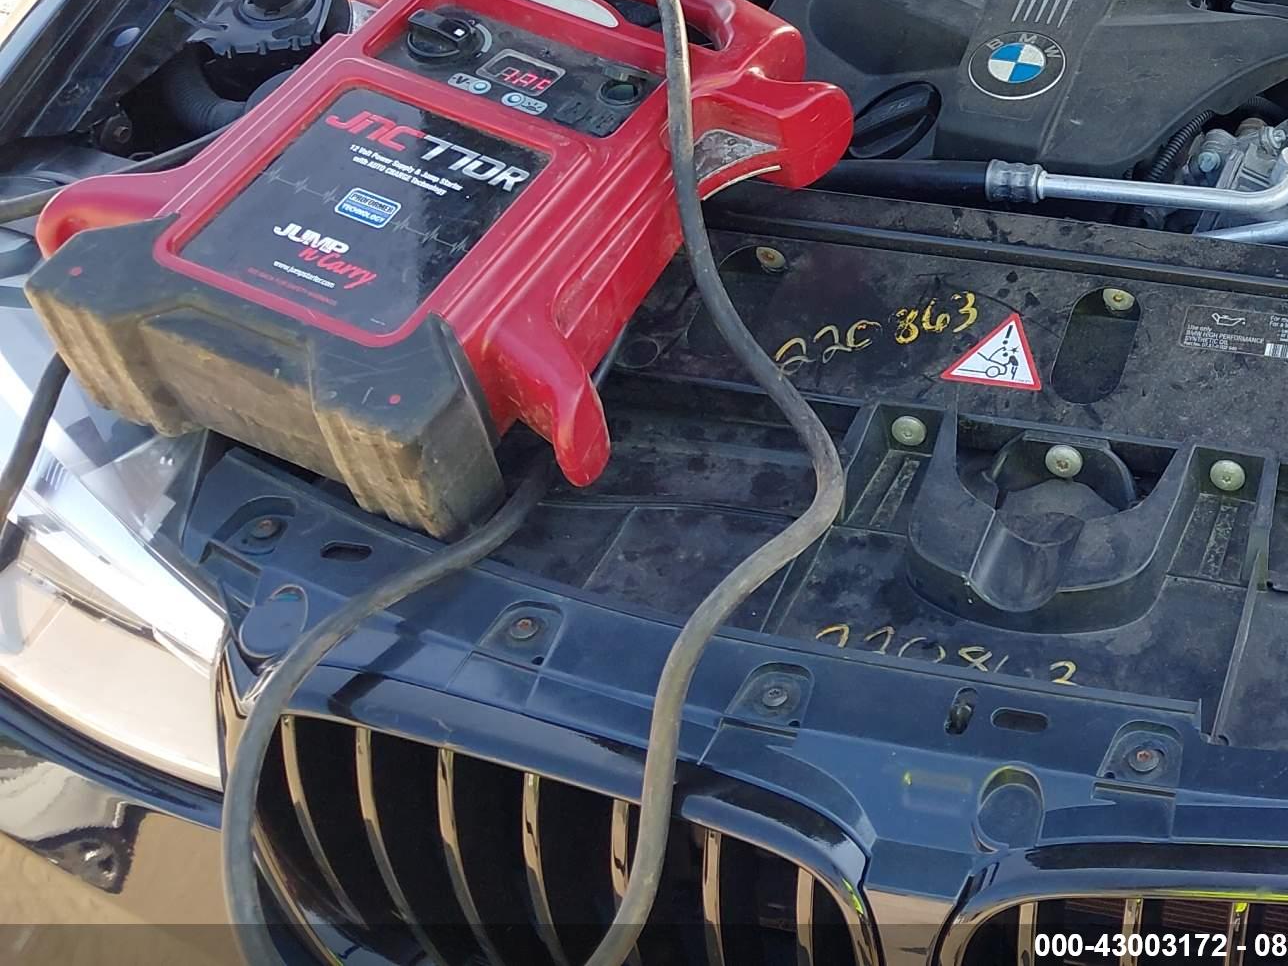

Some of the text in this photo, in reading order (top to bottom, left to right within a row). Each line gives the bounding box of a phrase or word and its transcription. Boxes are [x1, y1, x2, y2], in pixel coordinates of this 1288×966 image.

[350, 144, 360, 152] 12
[358, 146, 373, 157] Volt
[371, 152, 393, 164] Power
[392, 160, 415, 174] Supply
[420, 171, 440, 183] Jump
[439, 177, 464, 191] Starter
[352, 156, 448, 196] with AUTO CHARGE Technology
[273, 222, 350, 254] JUMP
[316, 252, 378, 290] Carry
[1219, 333, 1265, 344] PERFORMANCE
